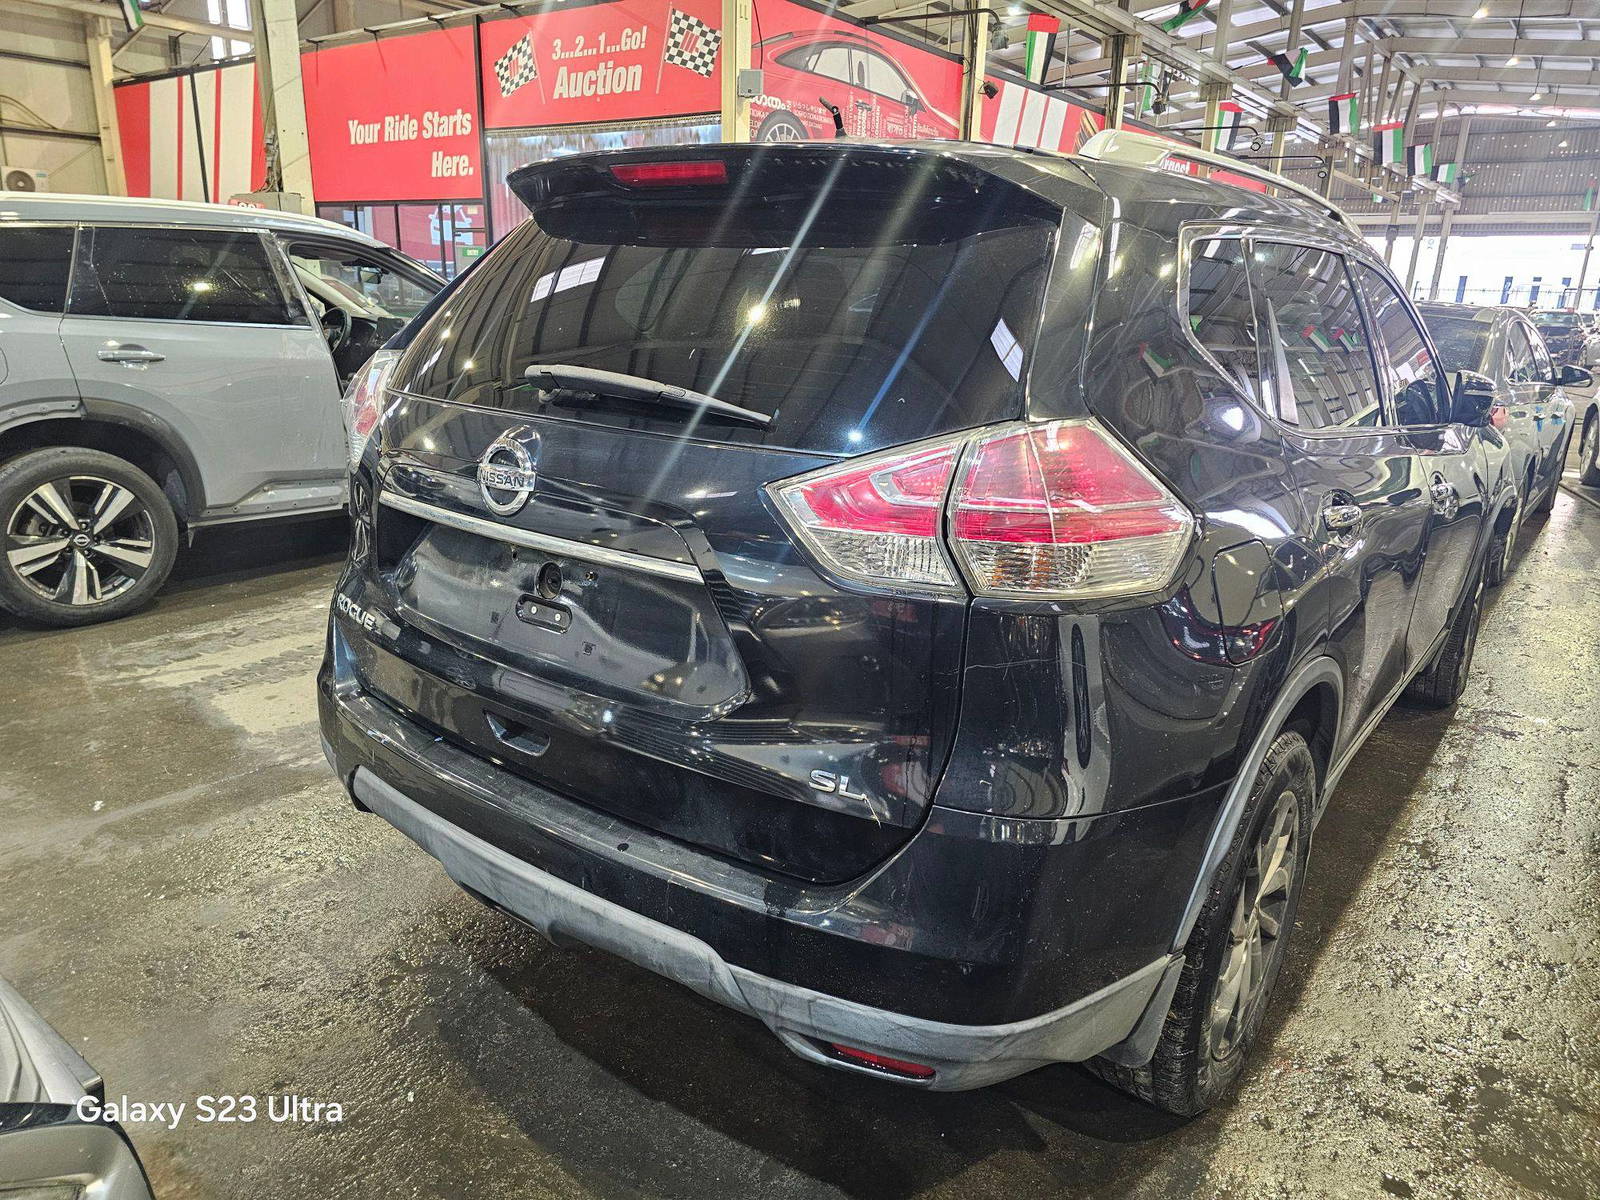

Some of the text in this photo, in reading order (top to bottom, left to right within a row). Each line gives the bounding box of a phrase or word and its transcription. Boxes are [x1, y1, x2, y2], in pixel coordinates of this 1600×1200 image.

[553, 60, 642, 100] Auction
[348, 108, 472, 145] Your Ride Starts
[431, 150, 474, 178] Here.
[481, 470, 525, 487] NISSAN
[337, 593, 376, 631] ROGUE
[808, 769, 866, 801] SL
